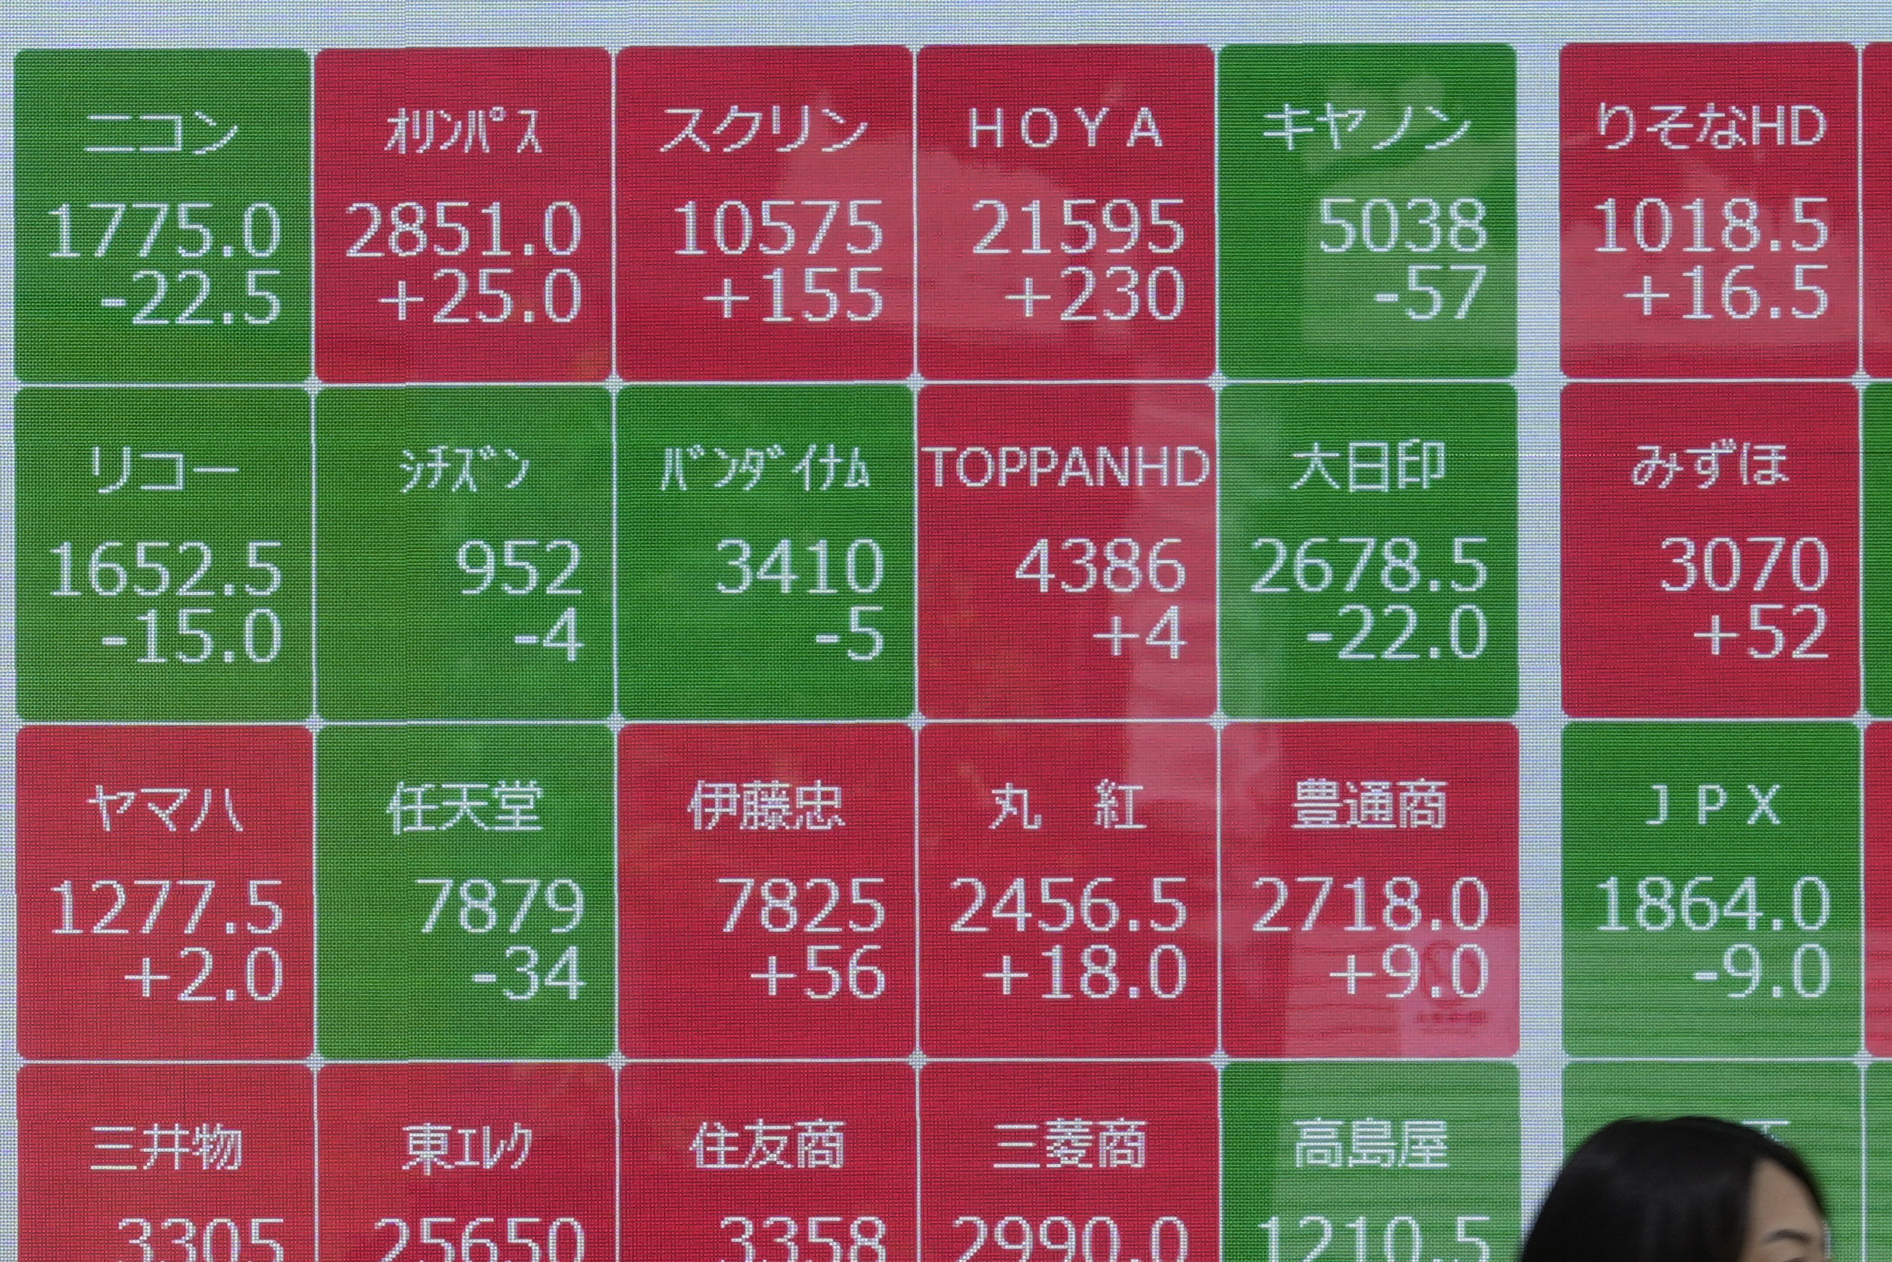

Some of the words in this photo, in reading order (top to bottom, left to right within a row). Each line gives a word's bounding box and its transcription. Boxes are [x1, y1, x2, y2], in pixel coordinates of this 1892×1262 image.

[84, 110, 240, 157] ニコン
[657, 103, 867, 155] スクリン
[1596, 101, 1829, 152] りそなHD
[49, 200, 282, 260] 1775.0
[344, 198, 584, 260] 2851.0
[673, 197, 885, 258] 10575
[970, 196, 1187, 257] 21595
[1317, 195, 1488, 255] 5038
[1594, 195, 1831, 255] 1018.5
[99, 267, 282, 327] -22.5
[377, 265, 584, 326] +25.0
[702, 264, 885, 325] +155
[1004, 263, 1187, 323] +230
[1623, 262, 1831, 322] +16.5
[89, 444, 239, 497] リコー
[919, 443, 1212, 490] TOPPANHD
[1291, 436, 1447, 494] 大日印
[1628, 436, 1790, 492] みずほ
[50, 539, 284, 599] 1652.5
[453, 537, 583, 597] 952
[714, 536, 886, 597] 3410
[1012, 536, 1188, 596] 4386
[1249, 535, 1489, 595] 2678.5
[1658, 534, 1831, 595] 3070
[99, 605, 284, 666] -15.0
[1306, 602, 1489, 662] -22.0
[1691, 601, 1830, 662] +52
[85, 783, 245, 833] ヤマハ
[384, 779, 544, 837] 任天堂
[685, 777, 847, 833] 伊藤忠
[1291, 775, 1448, 832] 豊通商
[51, 877, 285, 937] 1277.5
[414, 876, 586, 936] 7879
[715, 875, 888, 936] 7825
[948, 875, 1189, 935] 2456.5
[1249, 875, 1489, 935] 2718.0
[1599, 874, 1832, 933] 1864.0
[122, 944, 285, 1004] +2.0
[469, 943, 586, 1003] -34
[748, 942, 888, 1002] +56
[981, 941, 1189, 1002] +18.0
[1692, 941, 1832, 1000] -9.0
[88, 1122, 244, 1173] 三井物
[686, 1116, 846, 1172] 住友商
[990, 1115, 1148, 1171] 三菱商
[1293, 1116, 1448, 1170] 高島屋
